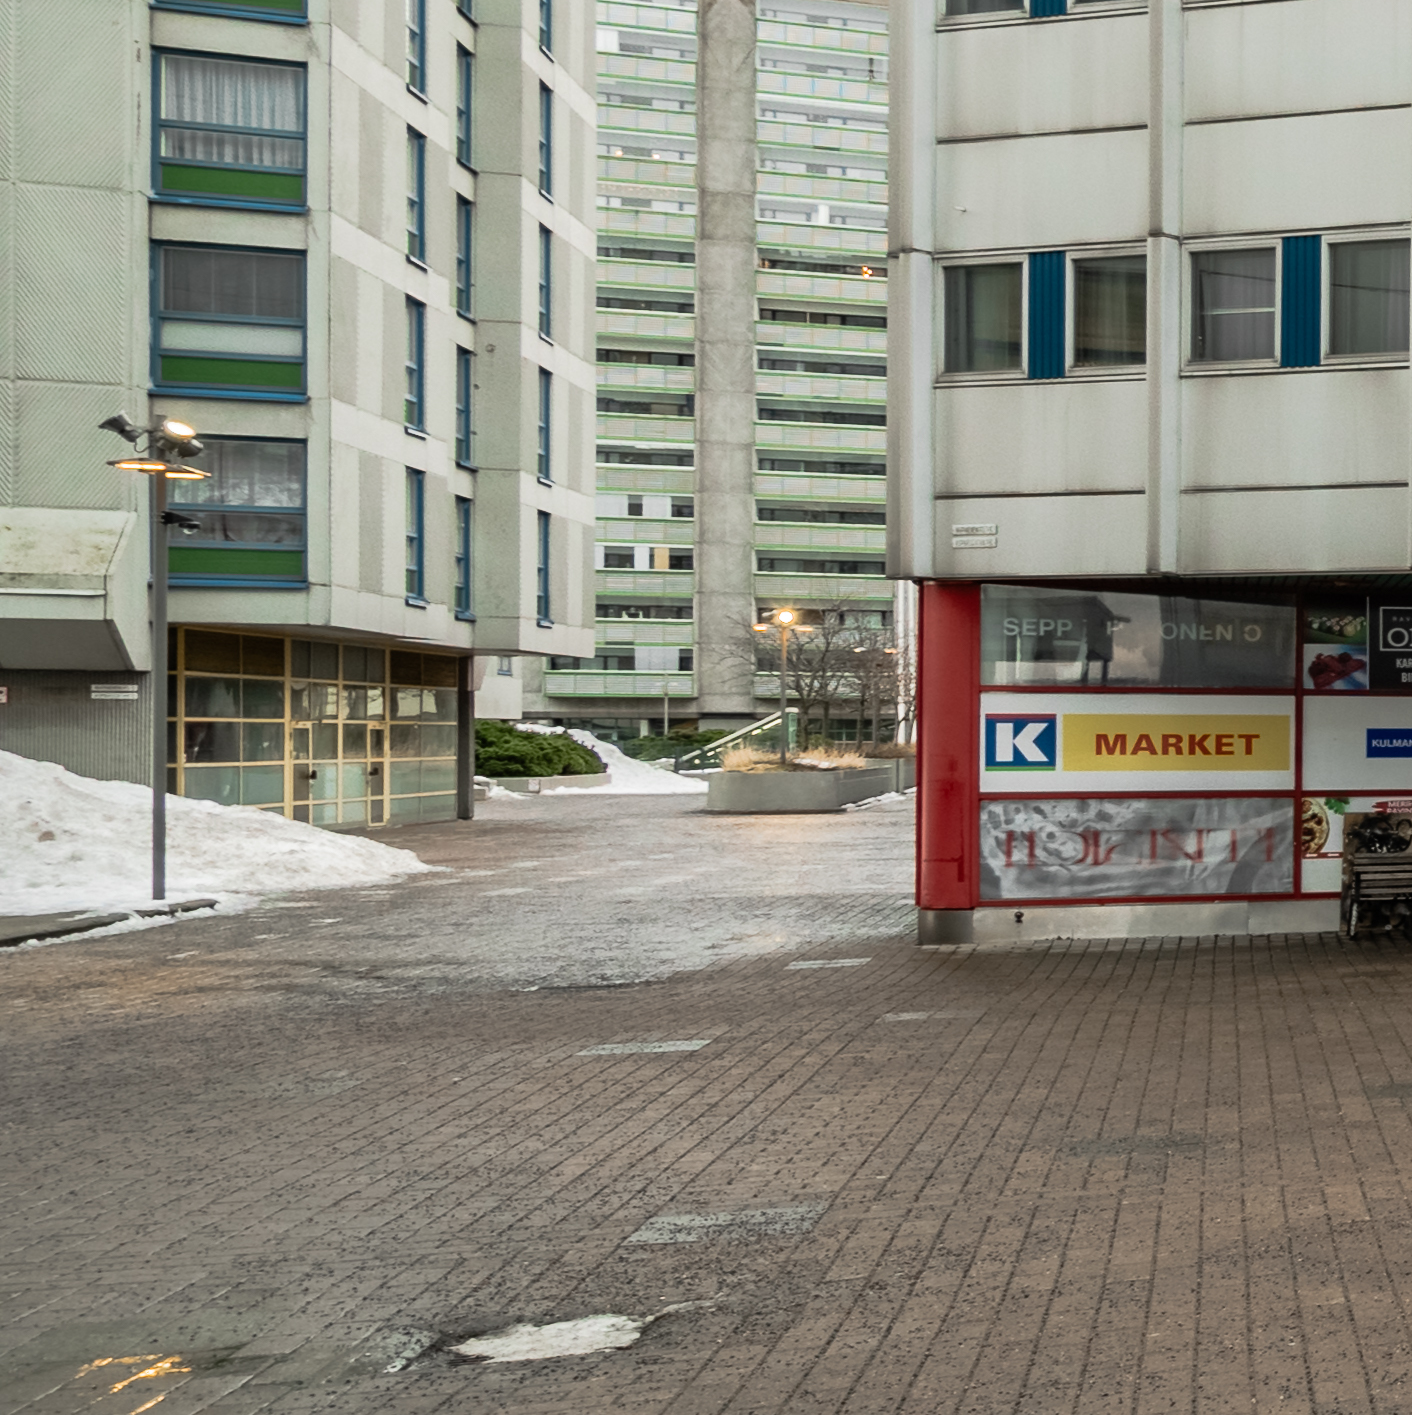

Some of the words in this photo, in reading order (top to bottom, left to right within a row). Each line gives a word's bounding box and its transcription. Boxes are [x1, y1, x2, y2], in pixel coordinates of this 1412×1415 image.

[1002, 617, 1089, 637] SEPP
[995, 722, 1050, 762] K
[1094, 733, 1261, 756] MARKET
